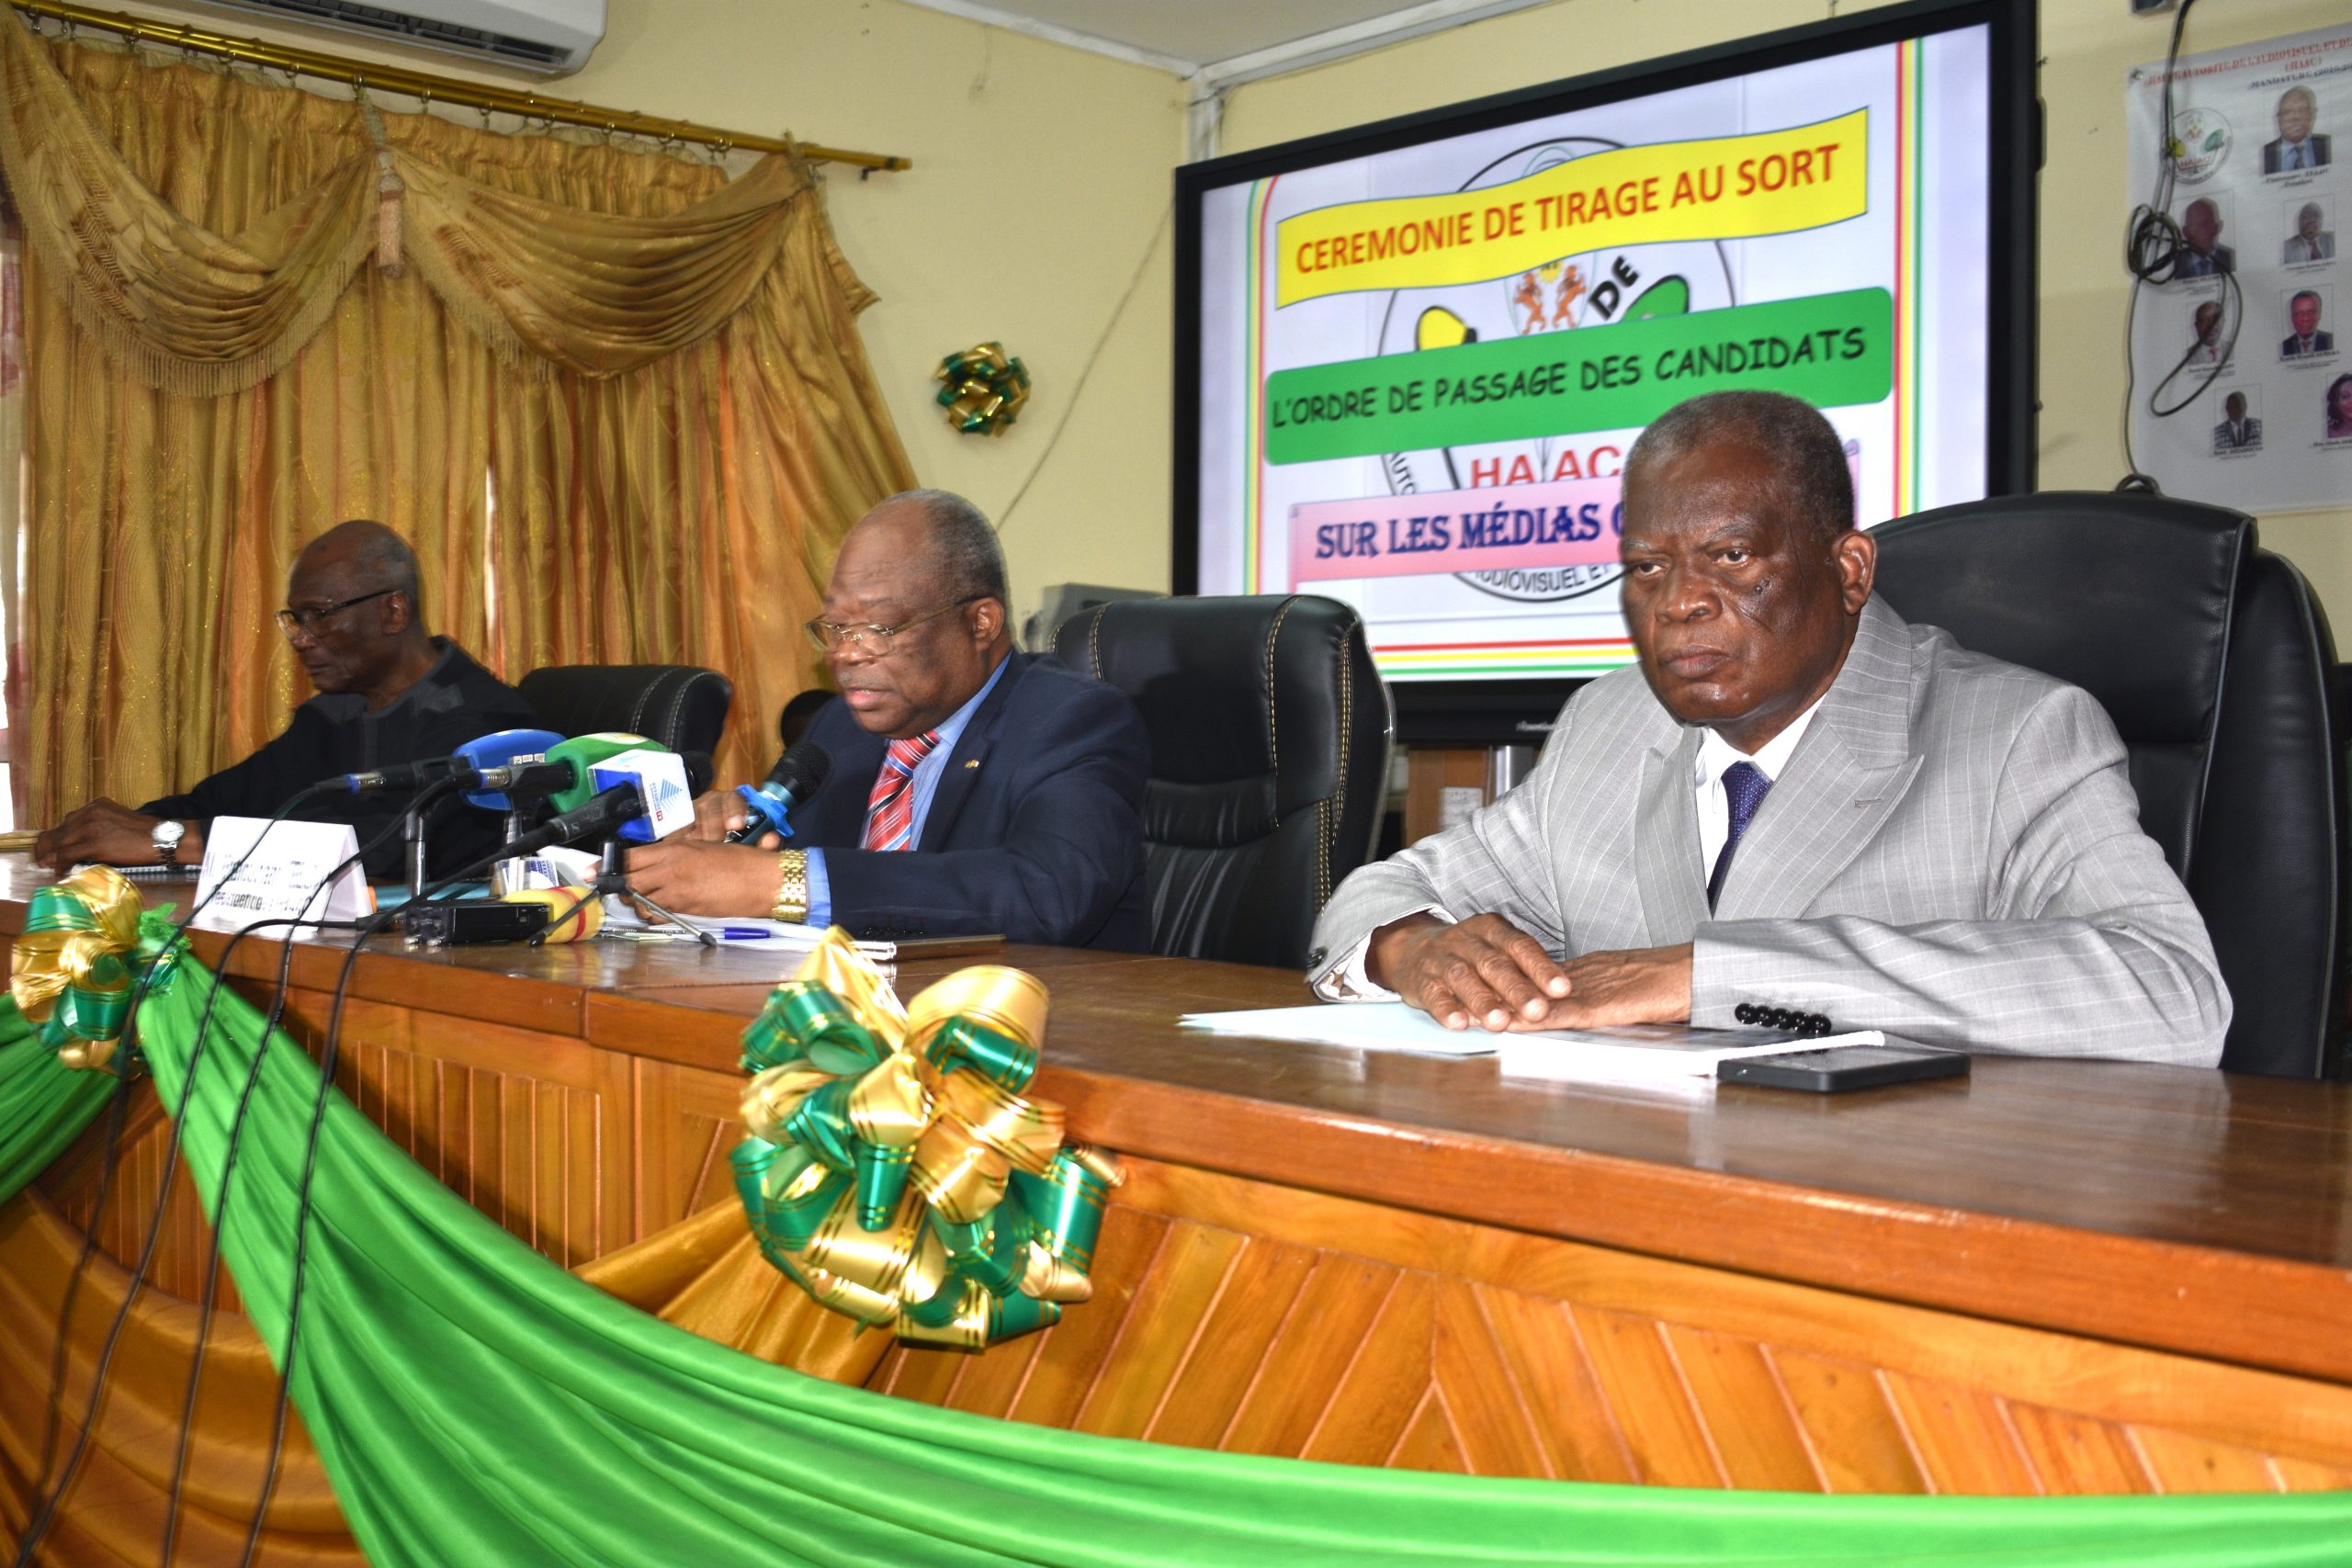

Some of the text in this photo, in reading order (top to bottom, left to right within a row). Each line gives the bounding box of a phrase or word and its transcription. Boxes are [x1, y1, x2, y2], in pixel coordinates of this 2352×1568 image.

[1296, 143, 1840, 274] CEREMONIE DE TIRAGE AU SORT
[1588, 255, 1641, 321] DE
[1272, 326, 1866, 428] L'ORDRE DE PASSAGE DES CANDIDATS
[1315, 521, 1379, 559] SUR
[1387, 514, 1453, 555] LES
[1458, 501, 1601, 549] MÉDIAS
[1475, 566, 1586, 593] UDIOVISUEL
